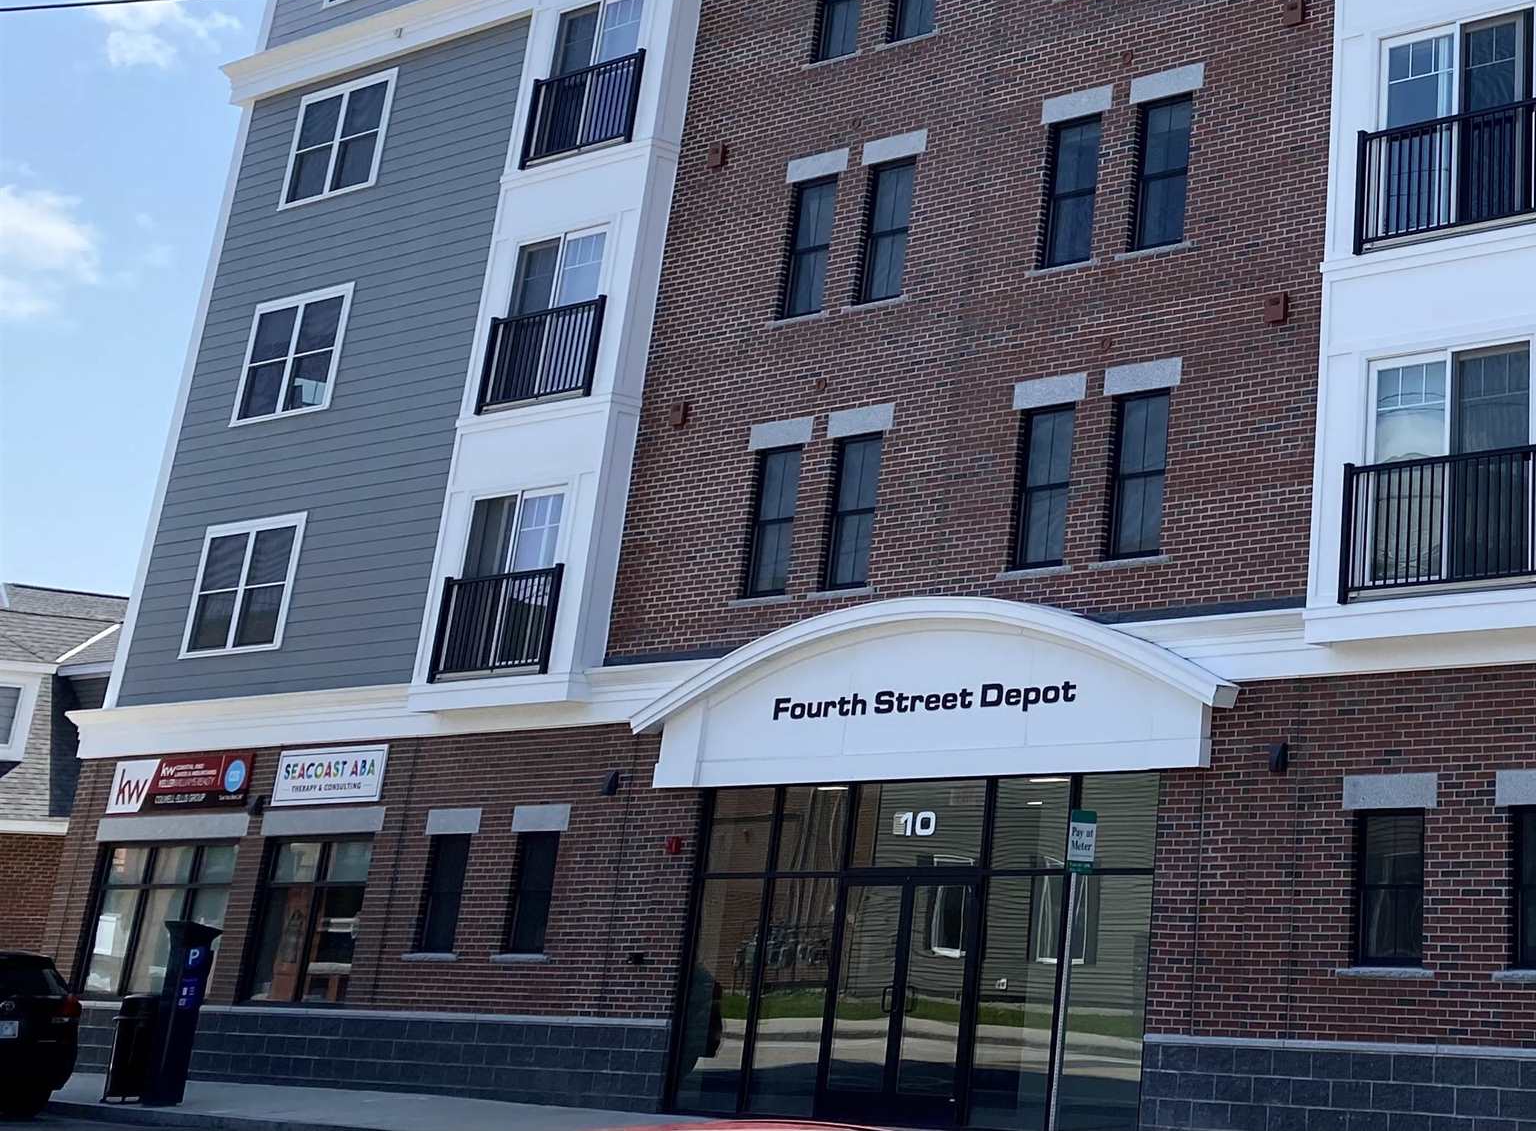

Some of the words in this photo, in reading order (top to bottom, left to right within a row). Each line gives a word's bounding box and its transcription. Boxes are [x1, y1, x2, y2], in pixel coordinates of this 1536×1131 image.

[772, 693, 867, 721] Fourth
[874, 688, 973, 715] Street
[980, 681, 1077, 712] Depot
[160, 762, 177, 777] kw
[283, 760, 348, 780] SEACOAST
[350, 758, 376, 778] ABA
[115, 768, 149, 806] kw
[291, 784, 317, 793] THERAPY
[323, 782, 361, 791] CONSULTING
[900, 811, 936, 837] 10
[1072, 826, 1084, 839] Pay
[1086, 829, 1094, 838] at
[1071, 840, 1093, 851] Meter
[188, 948, 200, 965] P
